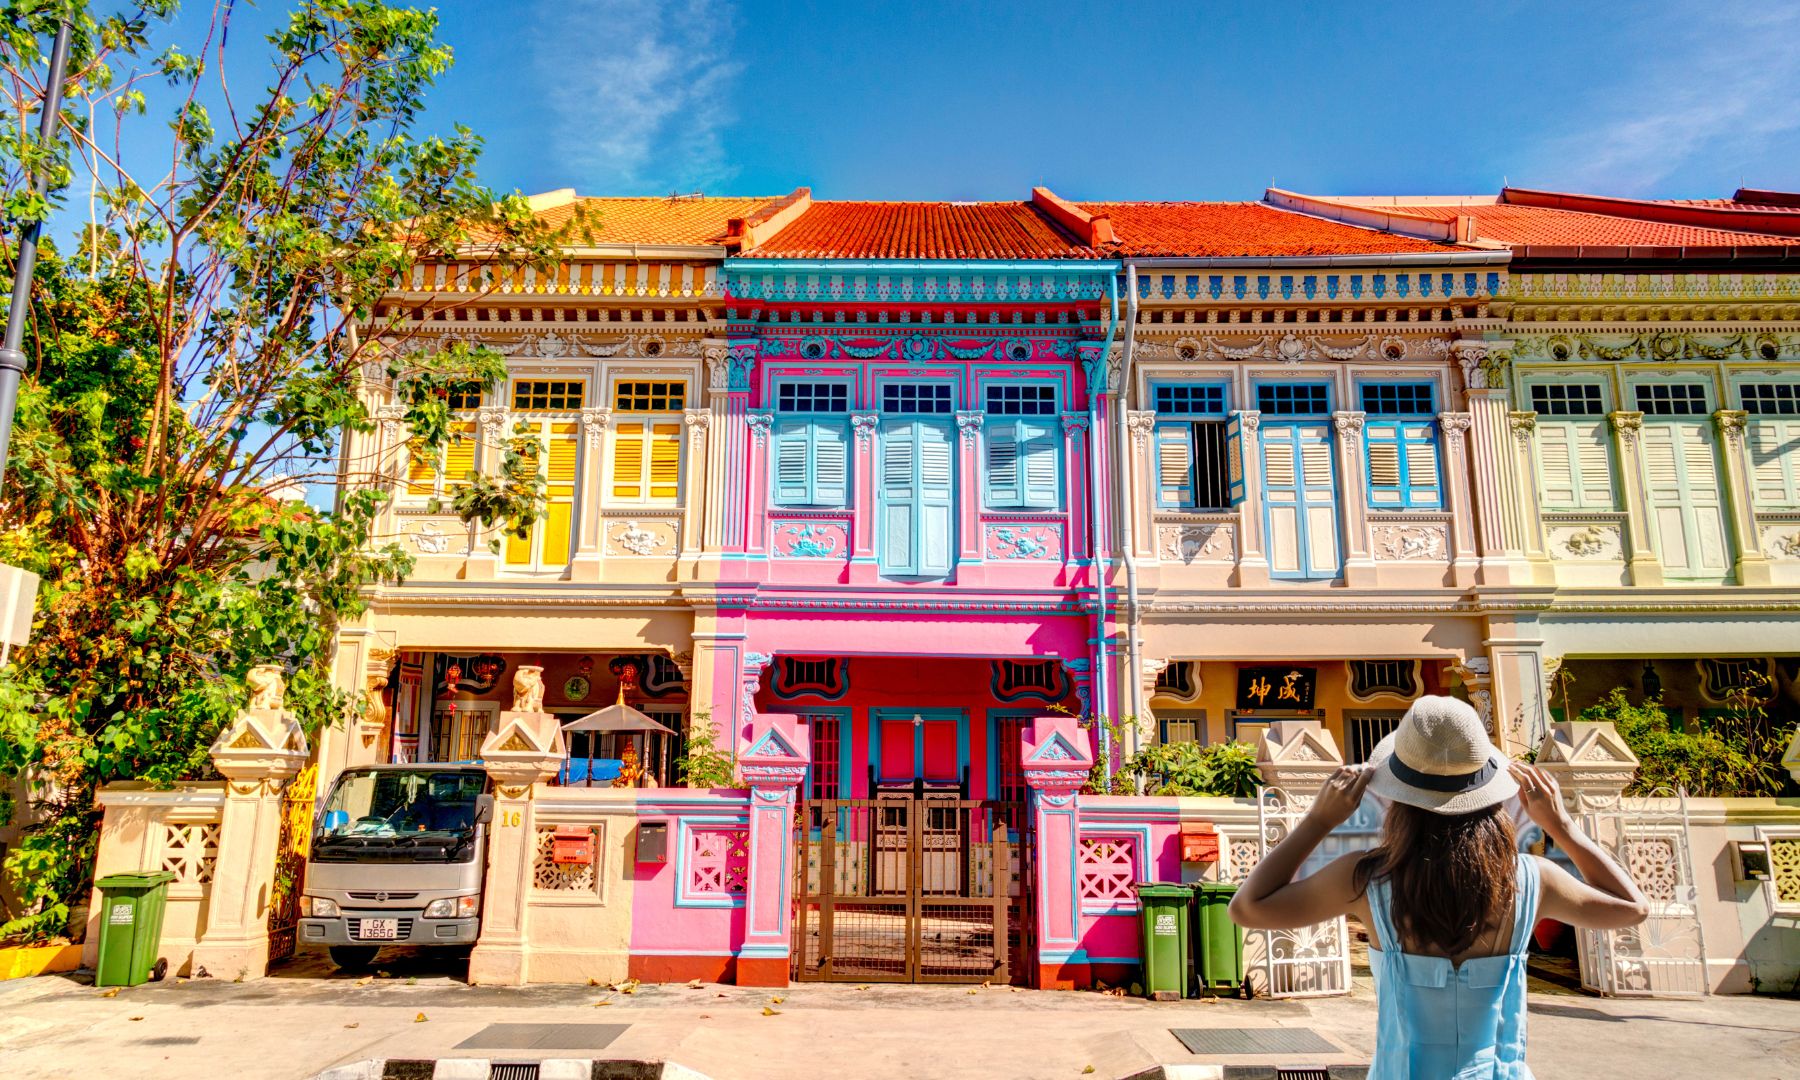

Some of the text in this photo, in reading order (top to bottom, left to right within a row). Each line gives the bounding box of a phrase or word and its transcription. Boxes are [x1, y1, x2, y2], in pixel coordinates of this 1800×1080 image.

[502, 810, 521, 827] 16
[372, 919, 385, 929] GX
[363, 928, 394, 938] 1365G
